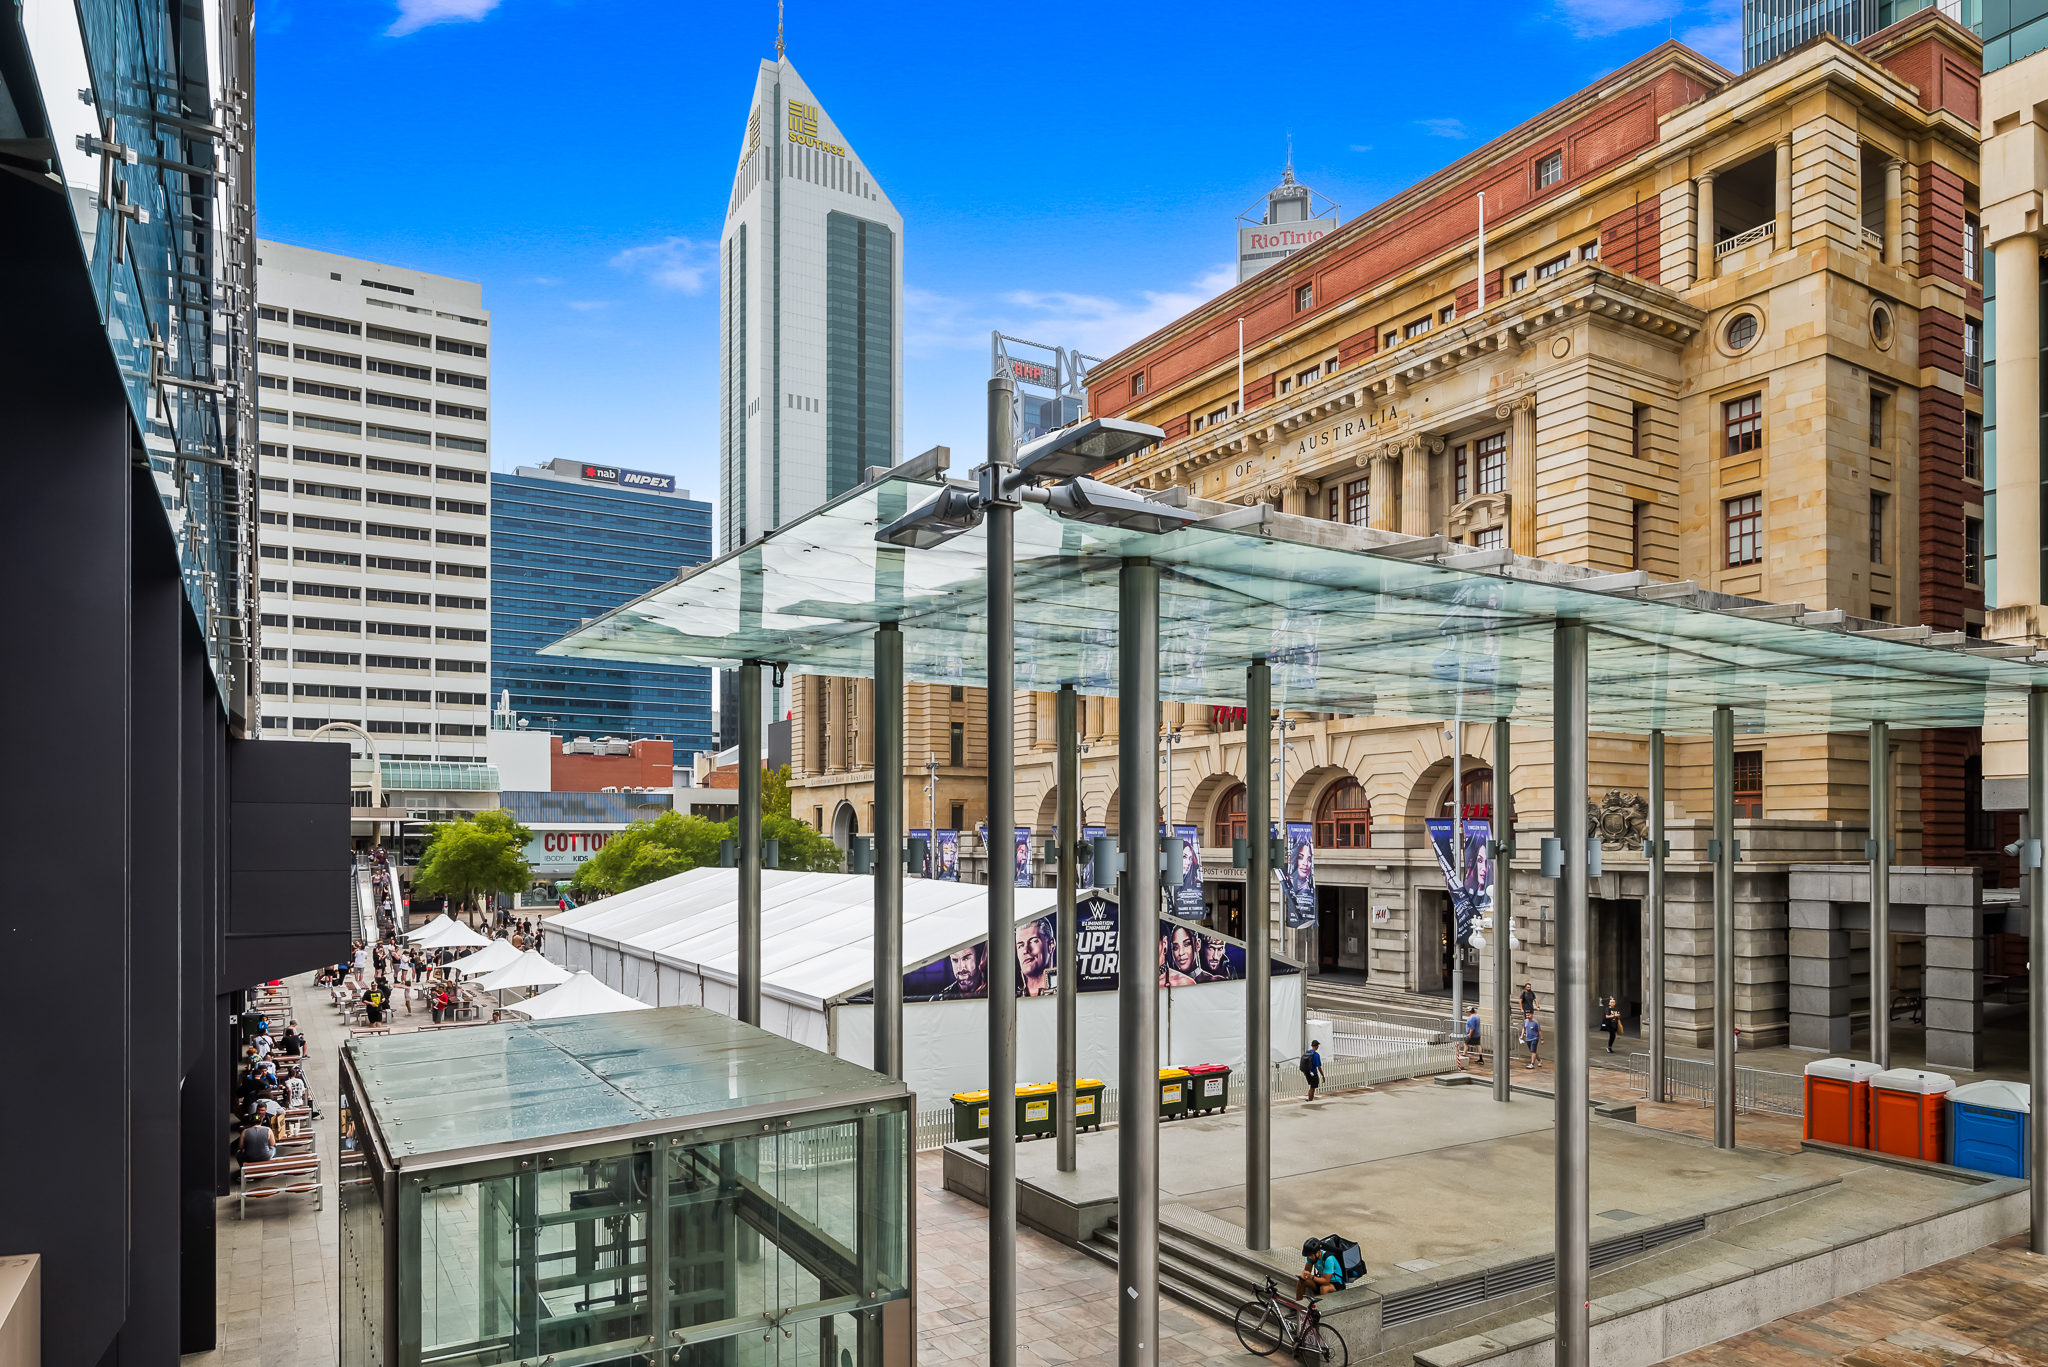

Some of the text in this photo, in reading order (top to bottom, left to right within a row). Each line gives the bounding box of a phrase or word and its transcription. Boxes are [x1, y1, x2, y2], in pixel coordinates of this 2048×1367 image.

[788, 131, 845, 157] SOUTH32
[1014, 363, 1041, 379] BHP
[1235, 405, 1398, 478] OF AUSTRALIA
[597, 469, 616, 479] nab
[624, 473, 670, 488] INPEX
[1203, 868, 1244, 876] POST OFFICE
[1076, 931, 1120, 952] UPE
[1076, 953, 1120, 975] TOR
